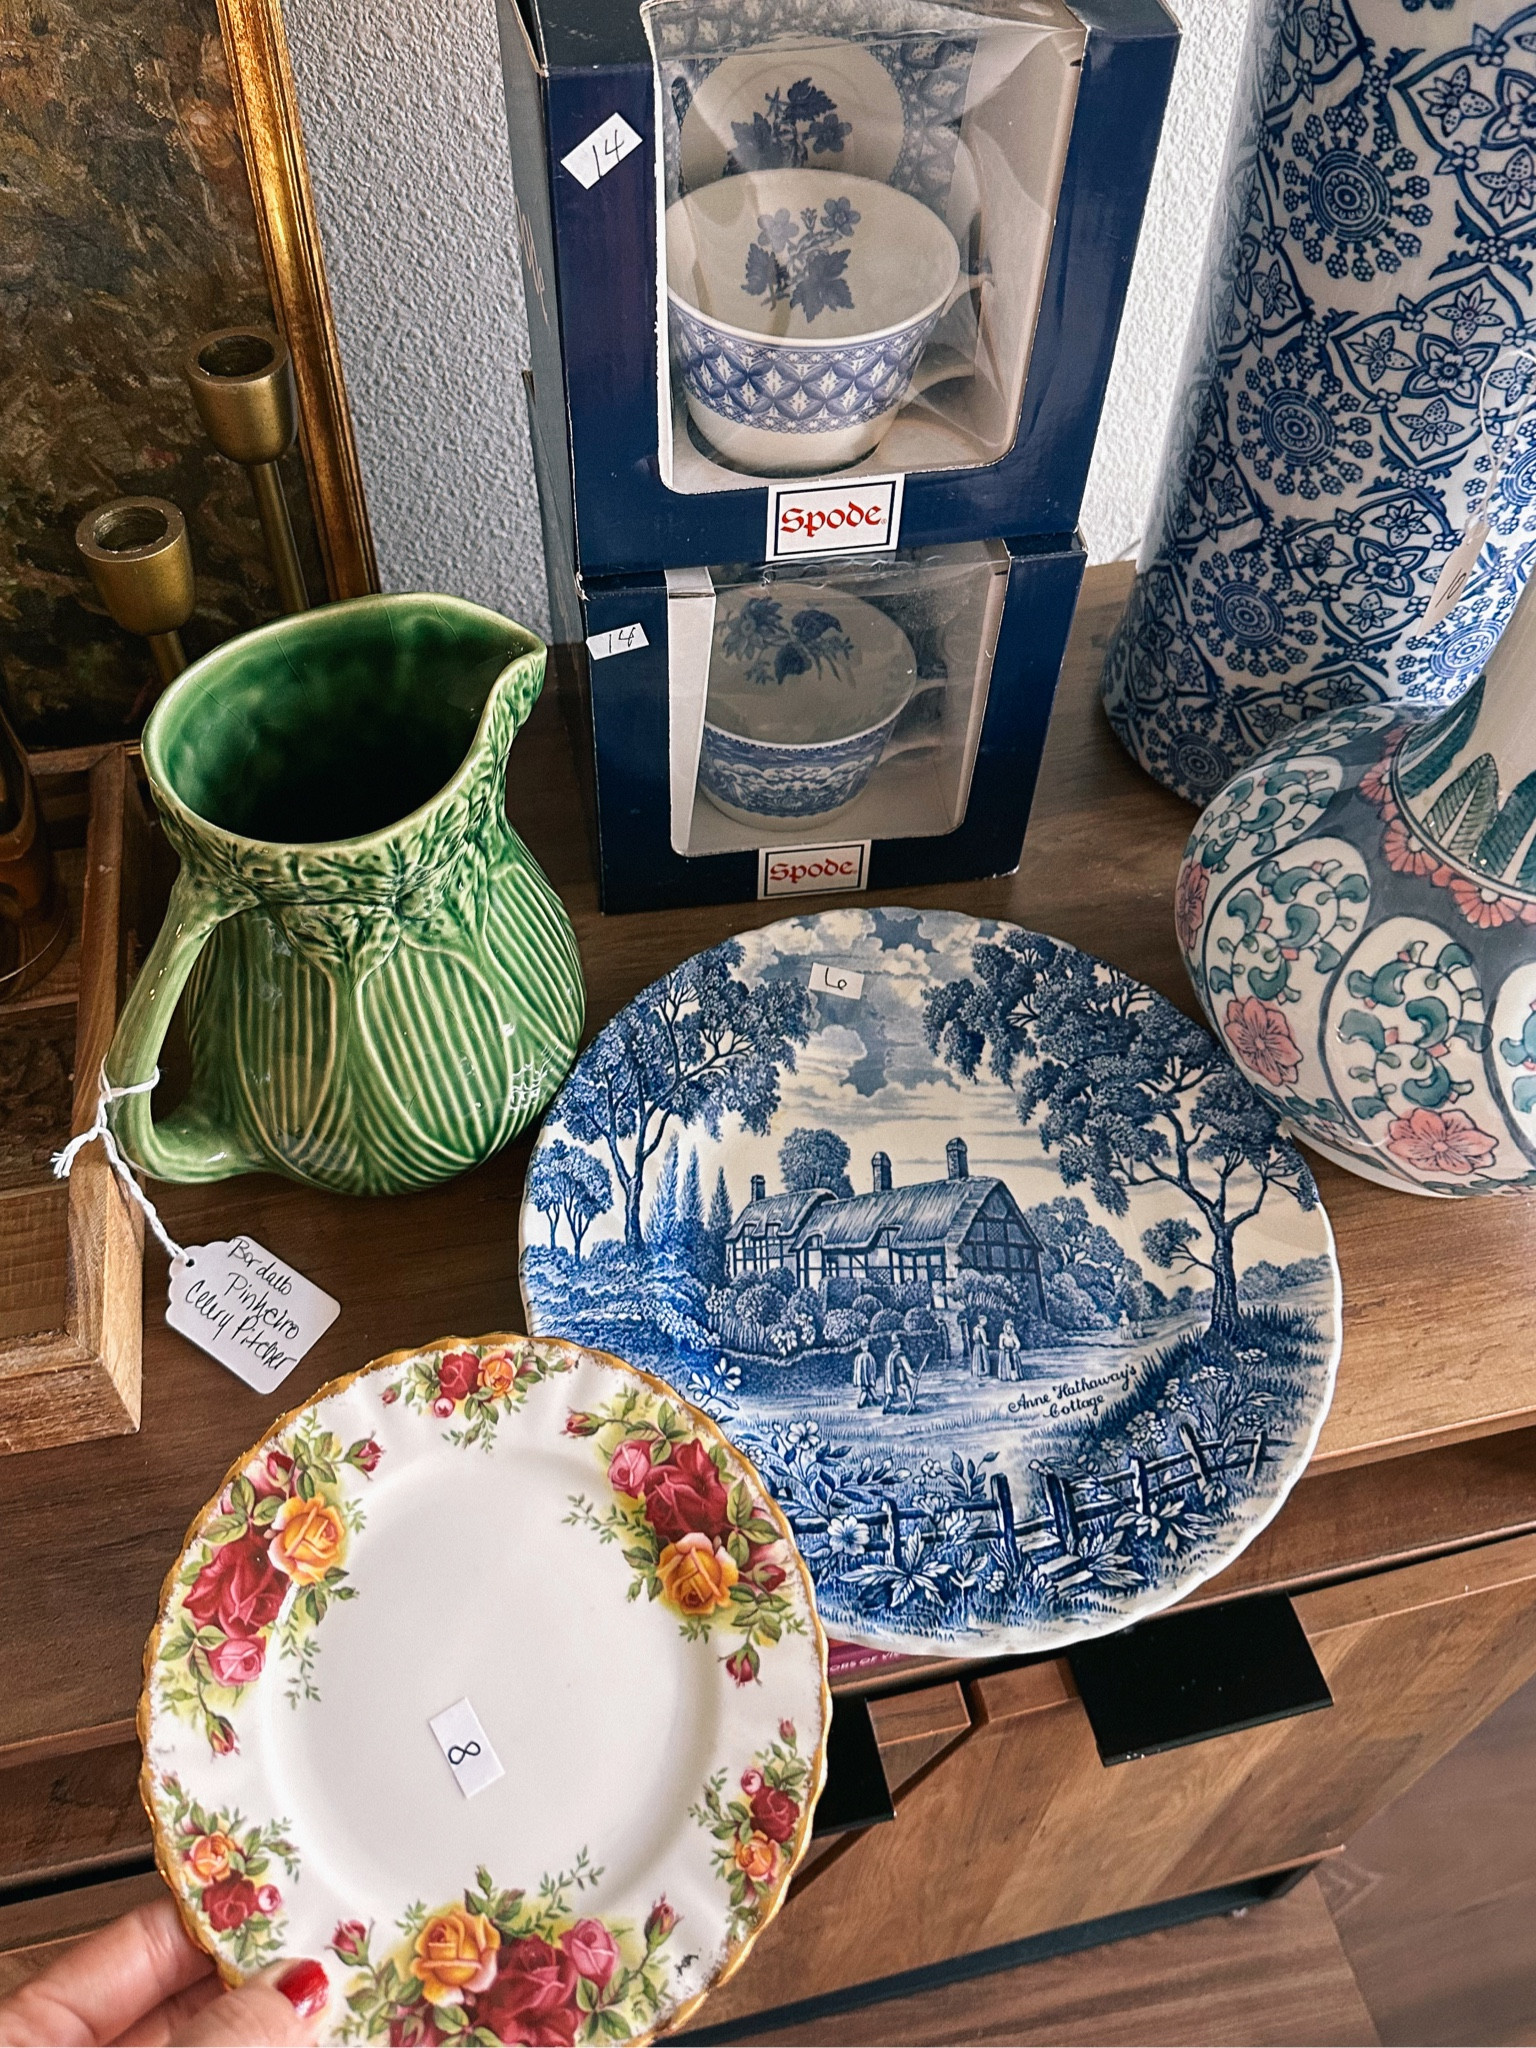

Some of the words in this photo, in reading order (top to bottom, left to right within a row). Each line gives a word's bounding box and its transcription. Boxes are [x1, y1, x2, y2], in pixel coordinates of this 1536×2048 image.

[591, 129, 625, 179] 14
[780, 500, 882, 538] Spode
[608, 626, 636, 654] 14
[769, 858, 854, 885] Spode
[824, 966, 848, 991] 6
[231, 1315, 298, 1370] Pitcher
[1008, 1393, 1050, 1414] Anne
[1052, 1363, 1138, 1400] Hathaway's
[1042, 1394, 1106, 1418] Cottage
[447, 1740, 481, 1765] 8
